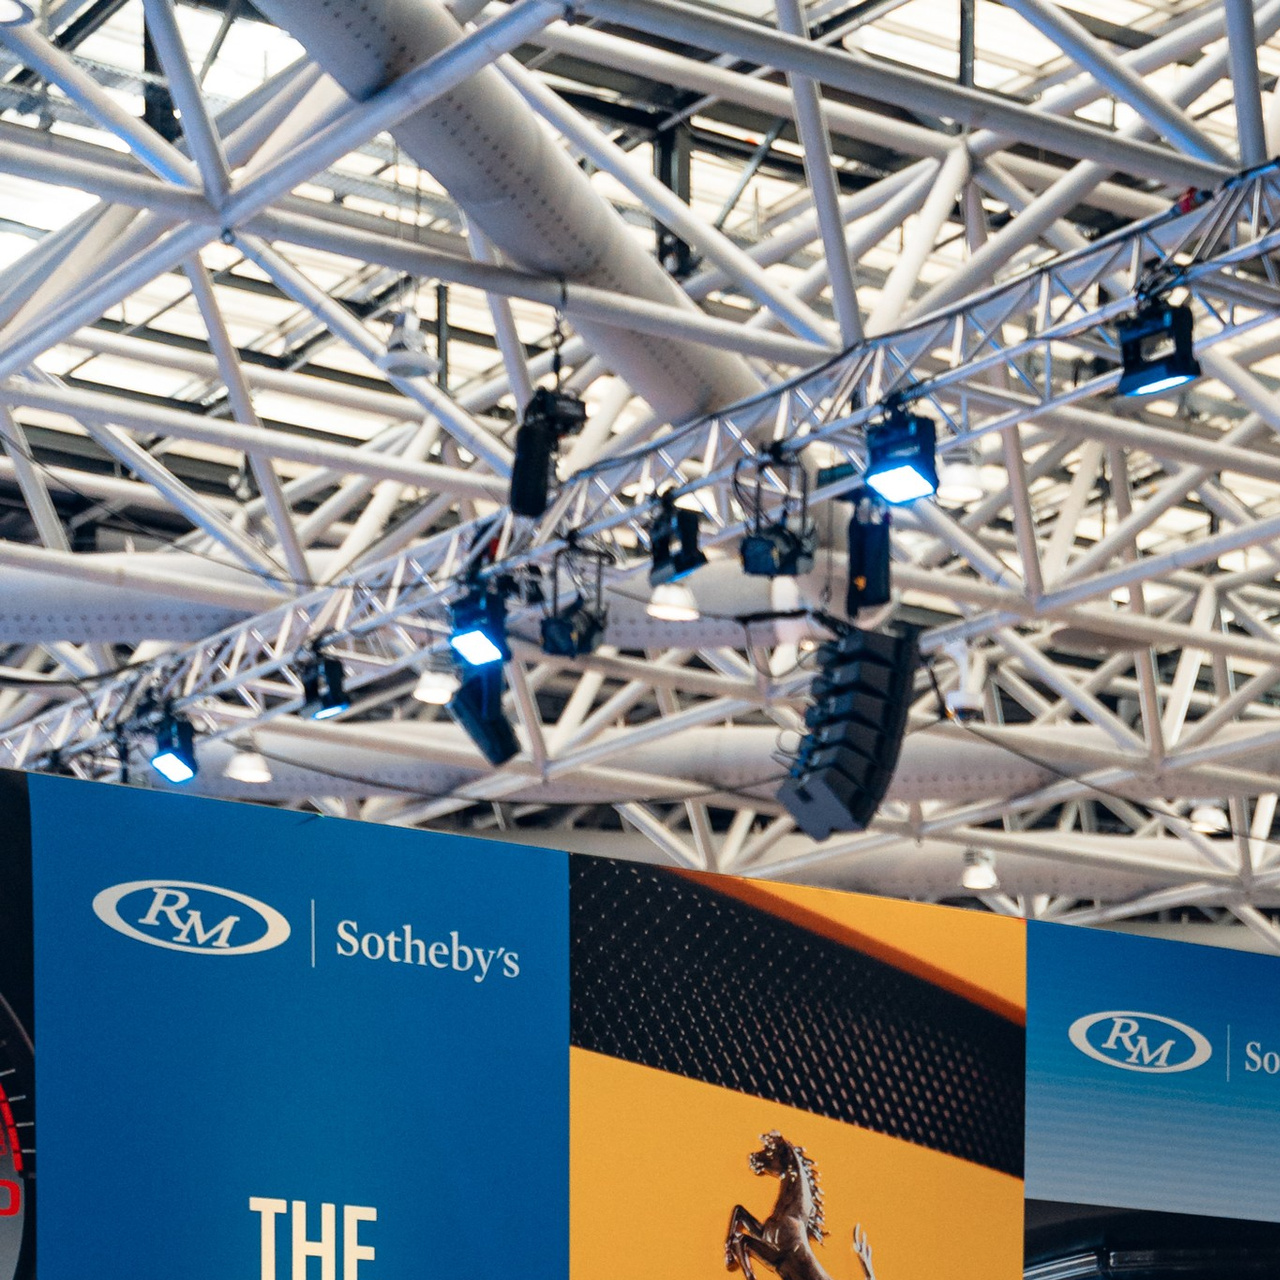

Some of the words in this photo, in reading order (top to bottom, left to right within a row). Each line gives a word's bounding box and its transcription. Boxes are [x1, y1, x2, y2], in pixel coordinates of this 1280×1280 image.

[138, 887, 241, 948] RM
[336, 920, 520, 983] Sotheby's
[1101, 1017, 1177, 1067] RM
